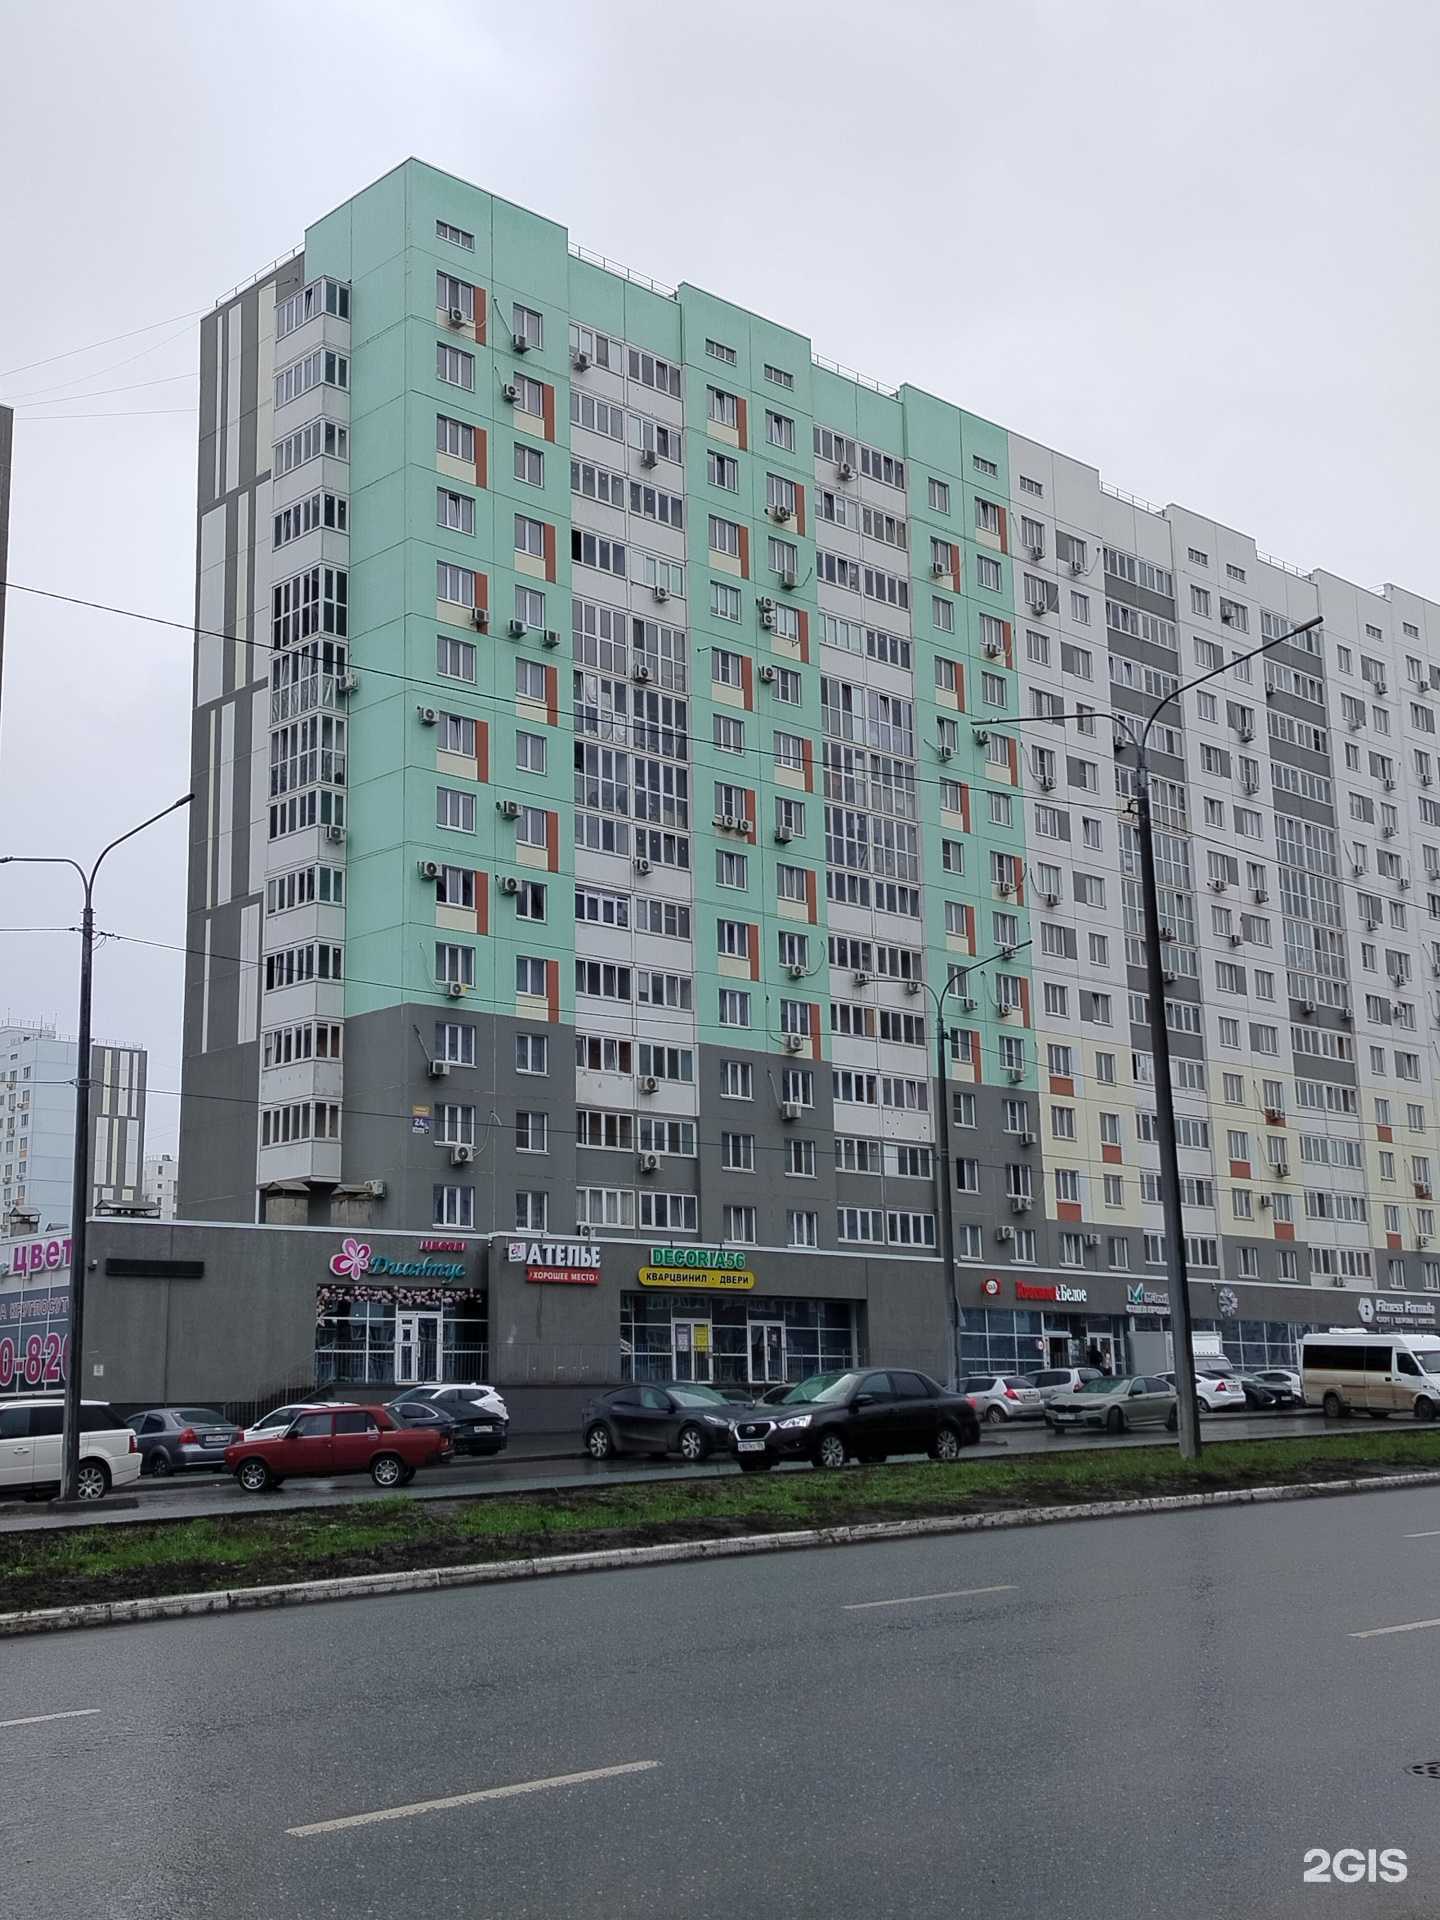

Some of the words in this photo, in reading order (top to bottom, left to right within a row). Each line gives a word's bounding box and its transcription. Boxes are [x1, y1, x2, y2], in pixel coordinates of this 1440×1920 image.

[526, 1243, 601, 1268] АТЕЛЬЕ
[651, 1247, 746, 1269] DECORIA56
[533, 1271, 568, 1281] ХОРОШЕЕ
[571, 1272, 595, 1281] МЕСТО
[646, 1272, 707, 1284] КВАРЦВИНИЛ
[720, 1275, 749, 1286] ДВЕРИ
